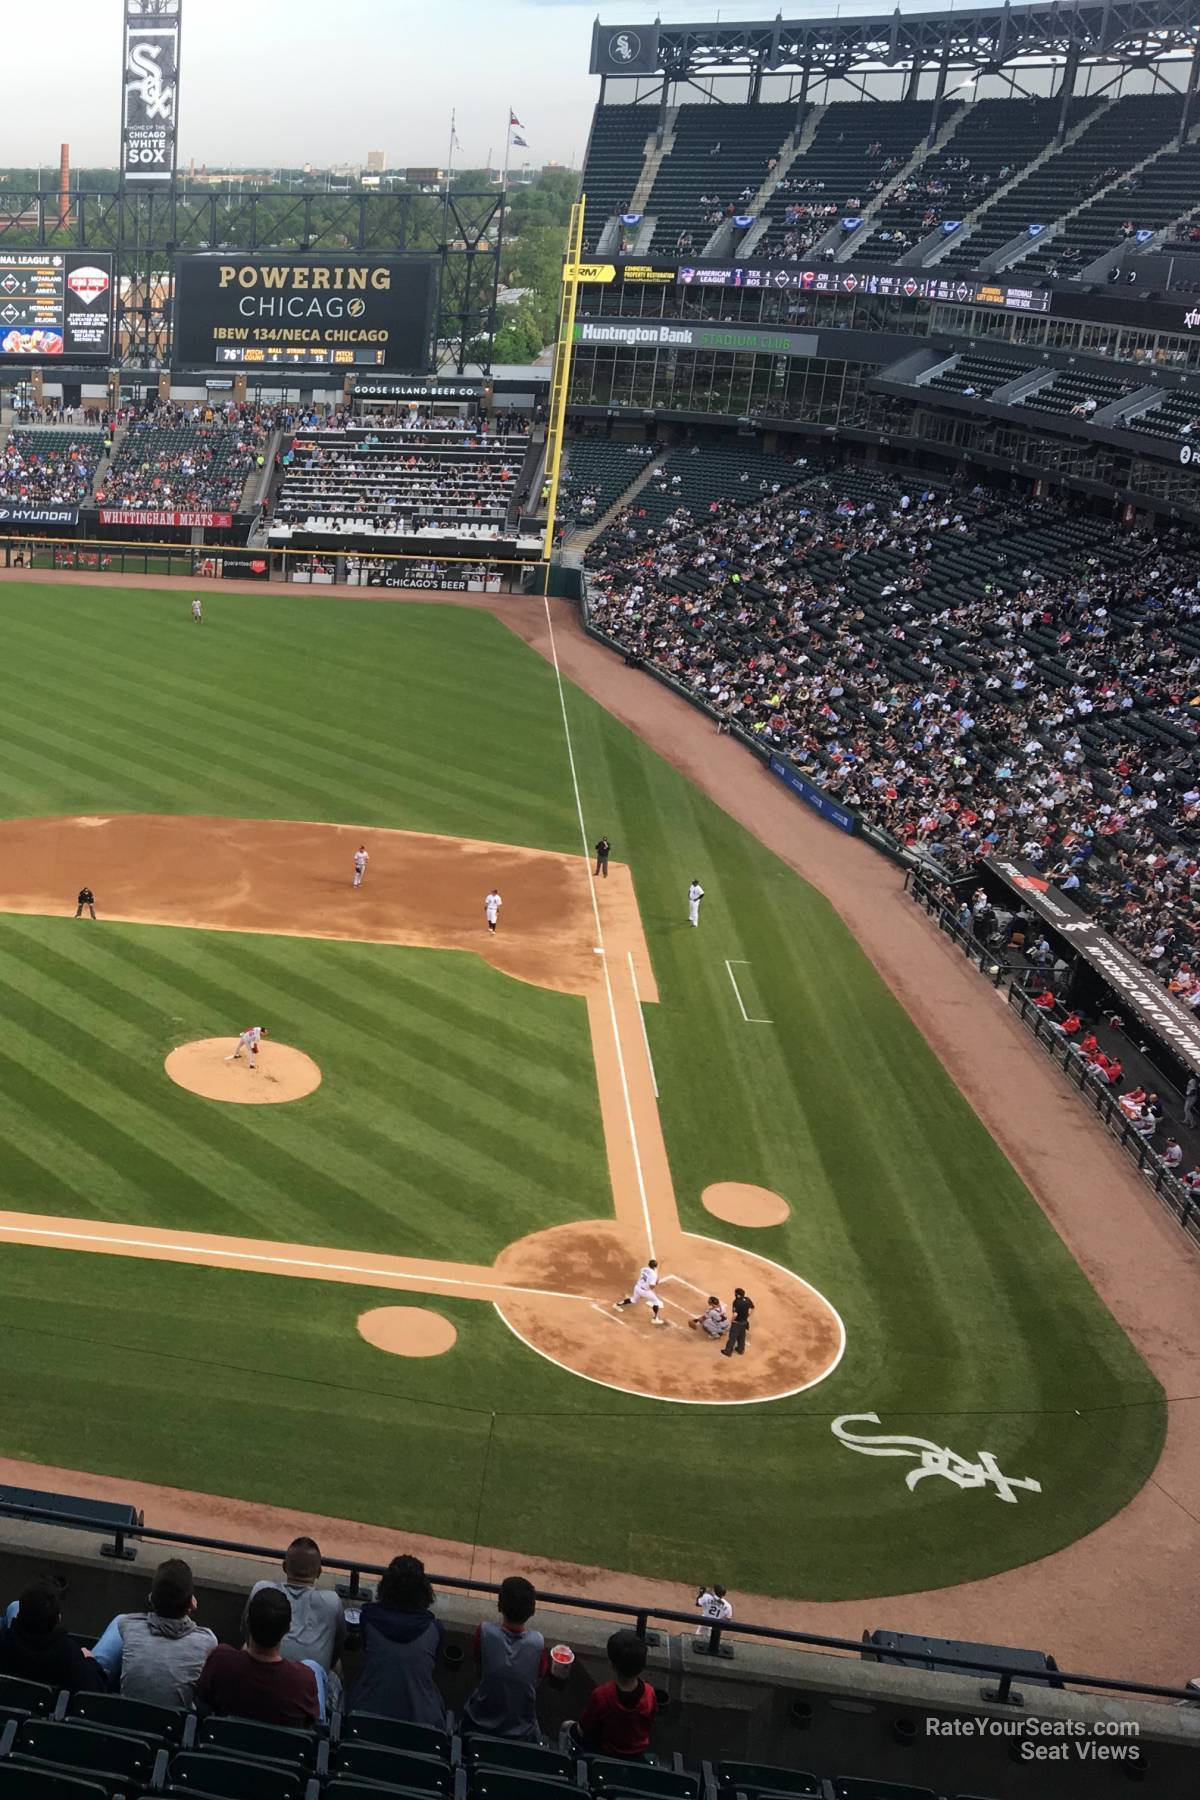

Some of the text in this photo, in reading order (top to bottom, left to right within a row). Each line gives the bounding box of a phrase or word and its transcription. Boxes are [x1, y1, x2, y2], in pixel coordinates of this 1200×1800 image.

[129, 131, 166, 139] CHICAGO
[129, 140, 166, 148] WHITE
[129, 150, 165, 163] SOX
[18, 256, 50, 264] LEAGUE
[219, 266, 391, 290] POWERING
[239, 295, 366, 318] CHICAGO
[213, 327, 389, 341] IBEW 134/NECA CHICAGO
[582, 324, 791, 349] Huntington Bank STADIUM CLUB
[355, 386, 477, 396] GOOSE ISLAND BEER CO.
[12, 509, 72, 521] HYUNDAI
[103, 511, 176, 525] WHITTINGHAM
[179, 512, 214, 526] MEATS
[386, 578, 465, 591] CHICAGO'S BEER
[1084, 946, 1164, 1013] AND CHECK-IN
[708, 1605, 721, 1618] 21
